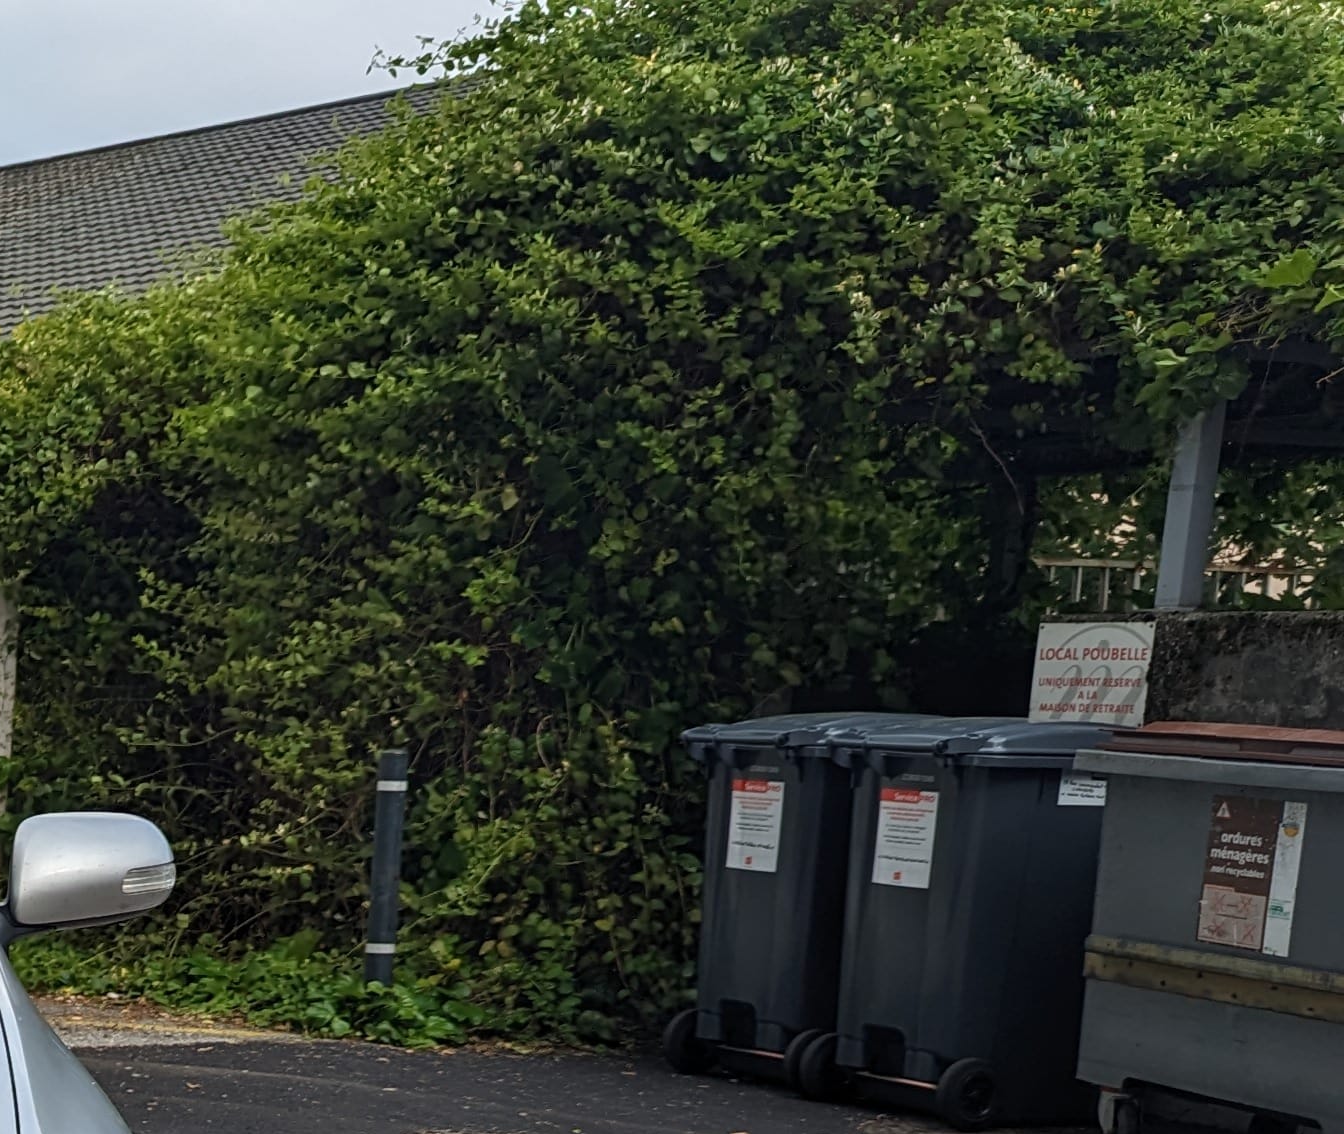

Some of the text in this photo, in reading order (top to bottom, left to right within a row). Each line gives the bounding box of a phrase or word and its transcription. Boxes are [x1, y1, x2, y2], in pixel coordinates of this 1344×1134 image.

[1039, 647, 1148, 660] LOCAL POUBELLE
[1039, 678, 1100, 688] UNIQUEMENT
[1086, 691, 1098, 700] LA
[1039, 703, 1134, 714] MAISON DE RETRAITE
[1221, 832, 1262, 847] ordures
[1210, 846, 1269, 865] ménagères
